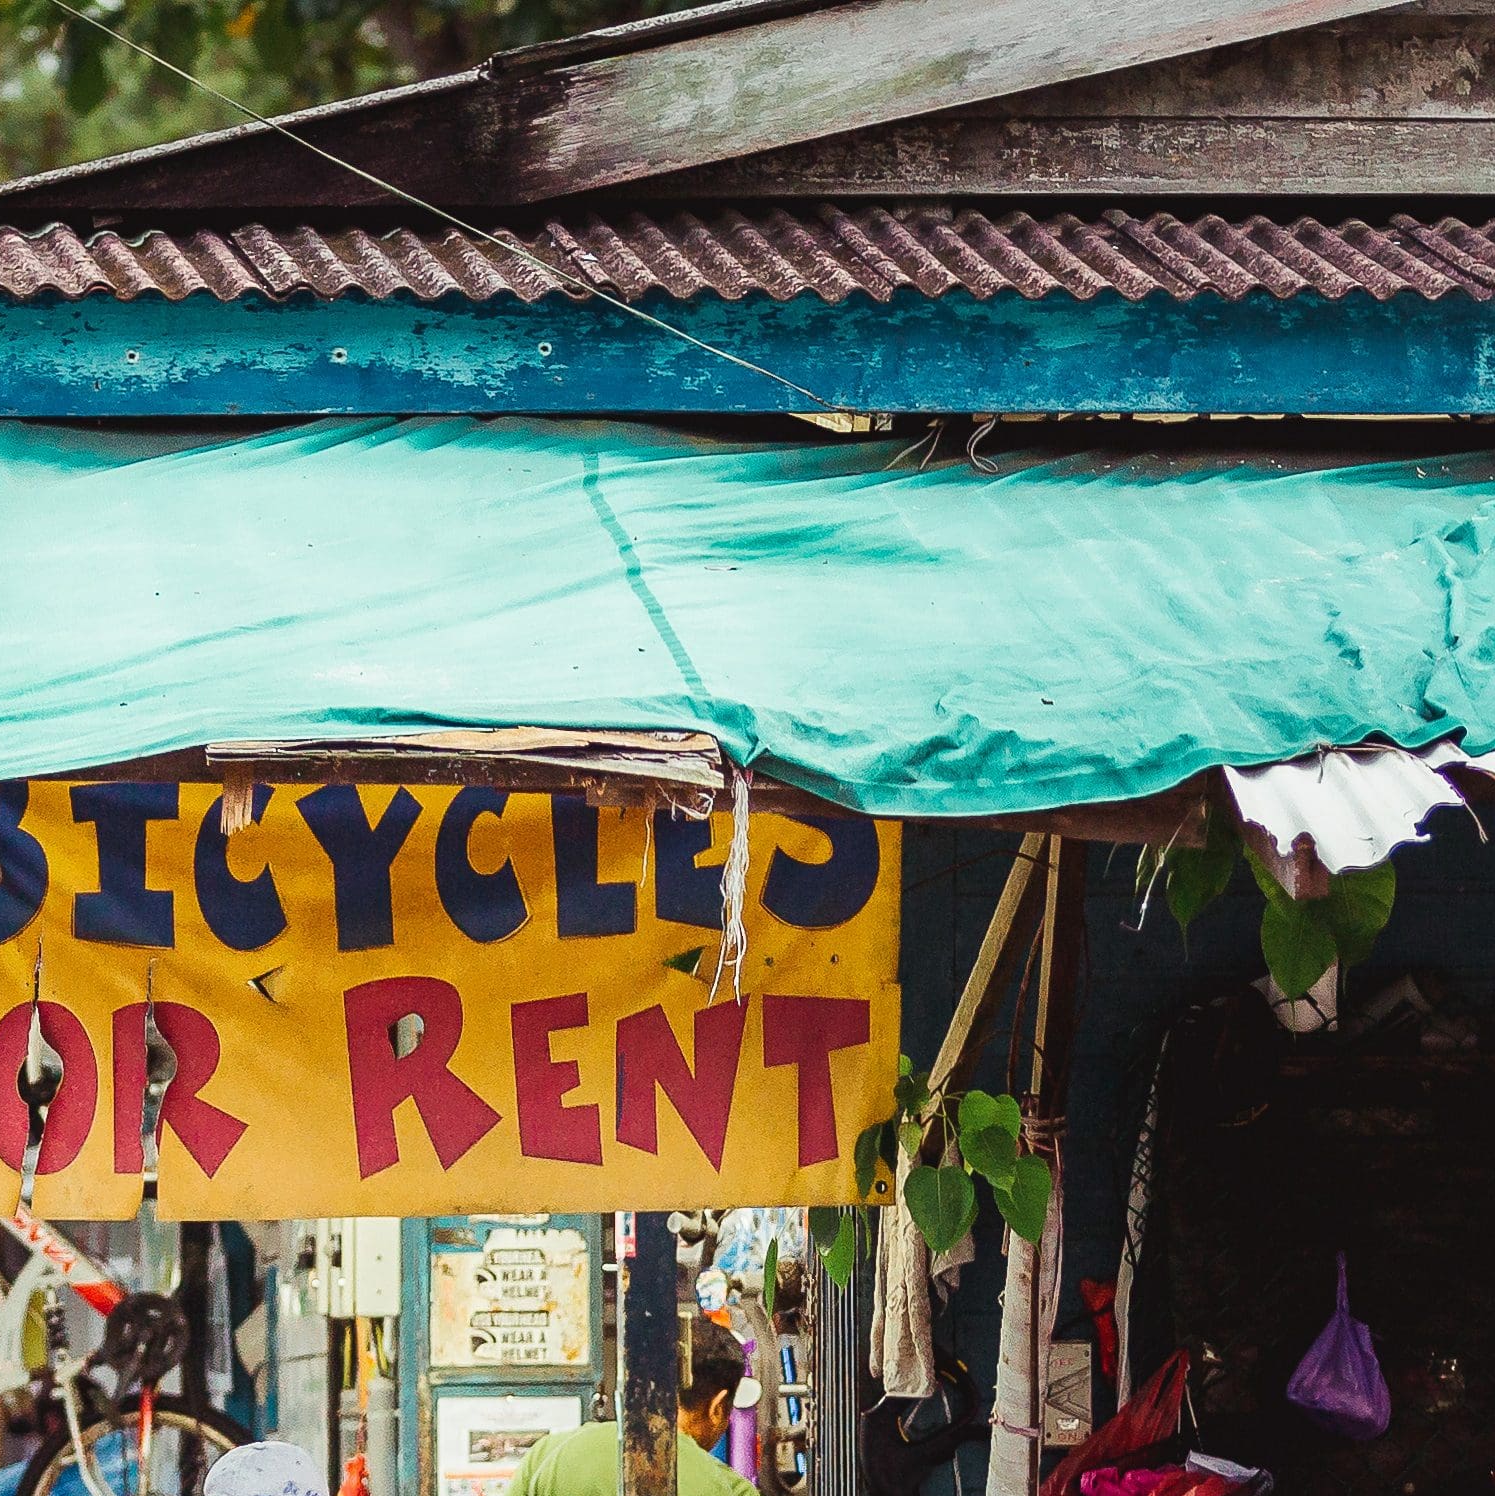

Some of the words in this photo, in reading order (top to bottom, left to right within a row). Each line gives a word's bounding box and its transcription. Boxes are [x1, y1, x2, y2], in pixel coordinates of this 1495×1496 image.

[343, 976, 871, 1180] RENT
[502, 1269, 533, 1281] WEAR
[502, 1286, 546, 1298] HELMET
[502, 1330, 533, 1343] WEAR
[539, 1331, 546, 1343] A
[502, 1347, 547, 1360] HELMET
